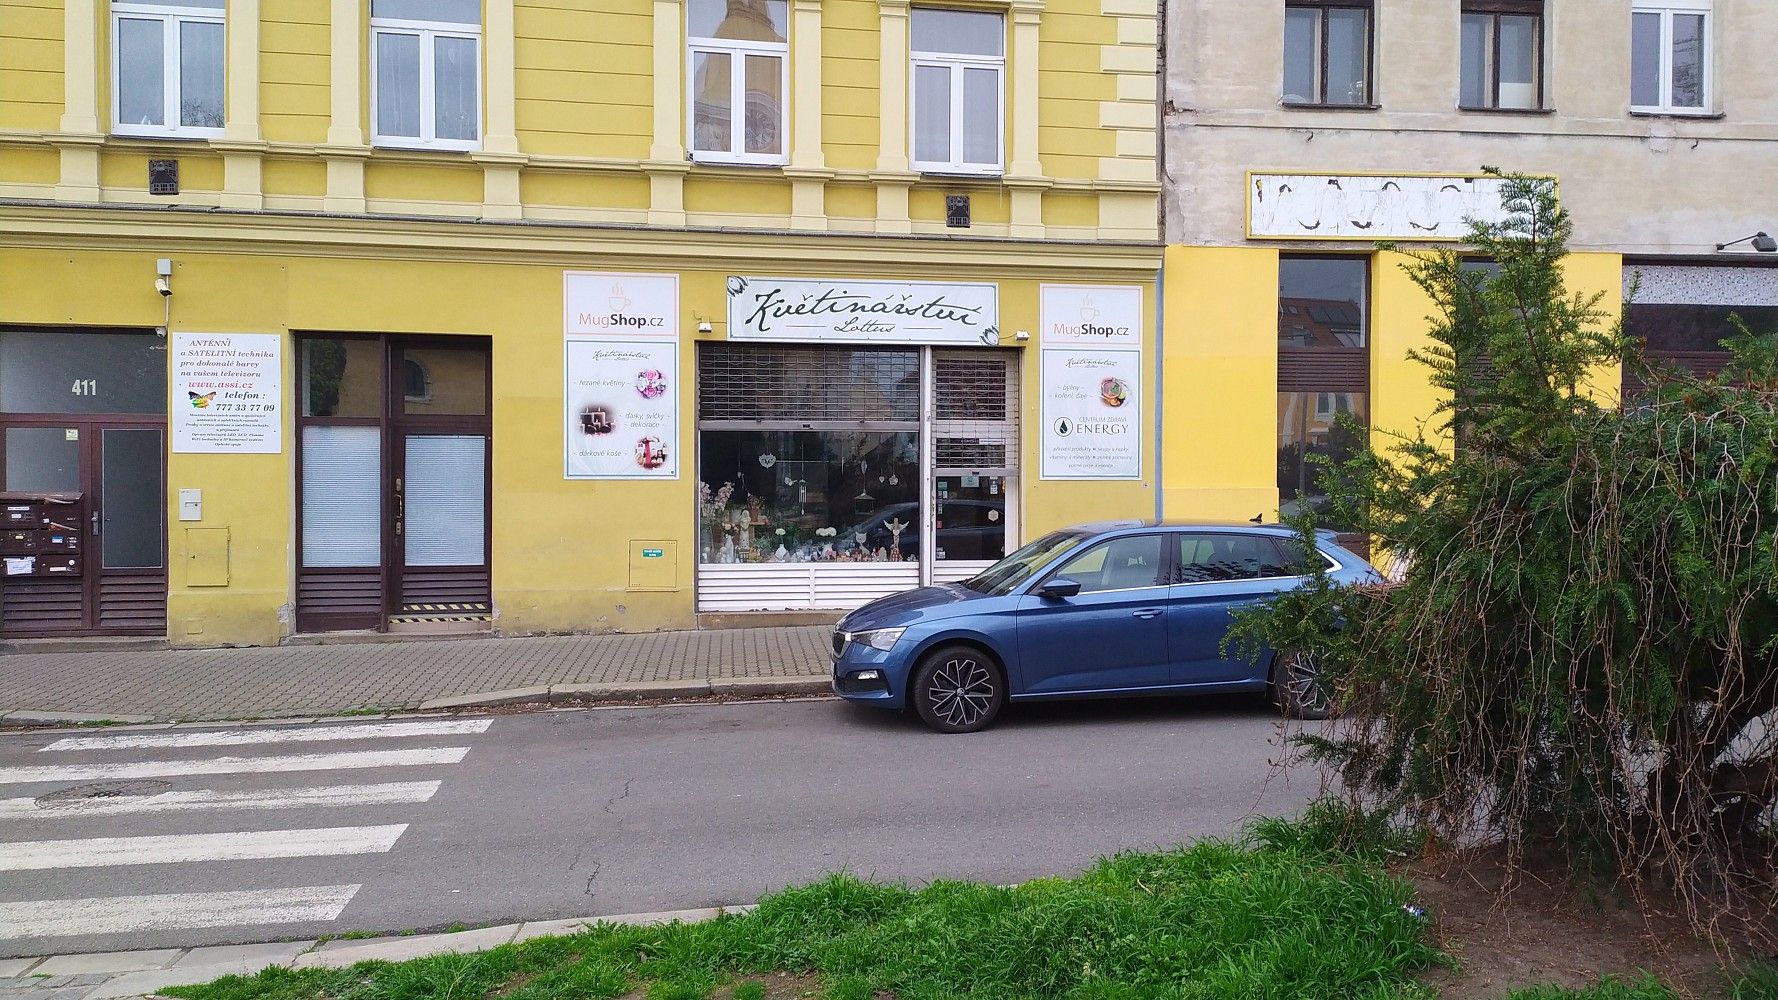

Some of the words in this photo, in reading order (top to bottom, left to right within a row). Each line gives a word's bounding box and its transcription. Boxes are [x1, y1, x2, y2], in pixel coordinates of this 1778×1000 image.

[745, 288, 983, 332] Květinářství
[579, 313, 664, 329] MugShop.cz
[833, 316, 897, 333] Lottus
[1053, 323, 1129, 338] MugShop.cz
[188, 349, 236, 357] SATELITNÍ
[236, 360, 260, 368] barvy
[220, 370, 261, 378] televizoru
[71, 379, 97, 396] 411
[188, 381, 254, 389] www.assi.cz
[602, 379, 626, 388] květiny
[225, 391, 259, 400] telefon
[216, 403, 233, 411] 777
[250, 404, 261, 412] 77
[263, 404, 275, 412] 09
[1076, 424, 1129, 435] ENERGY
